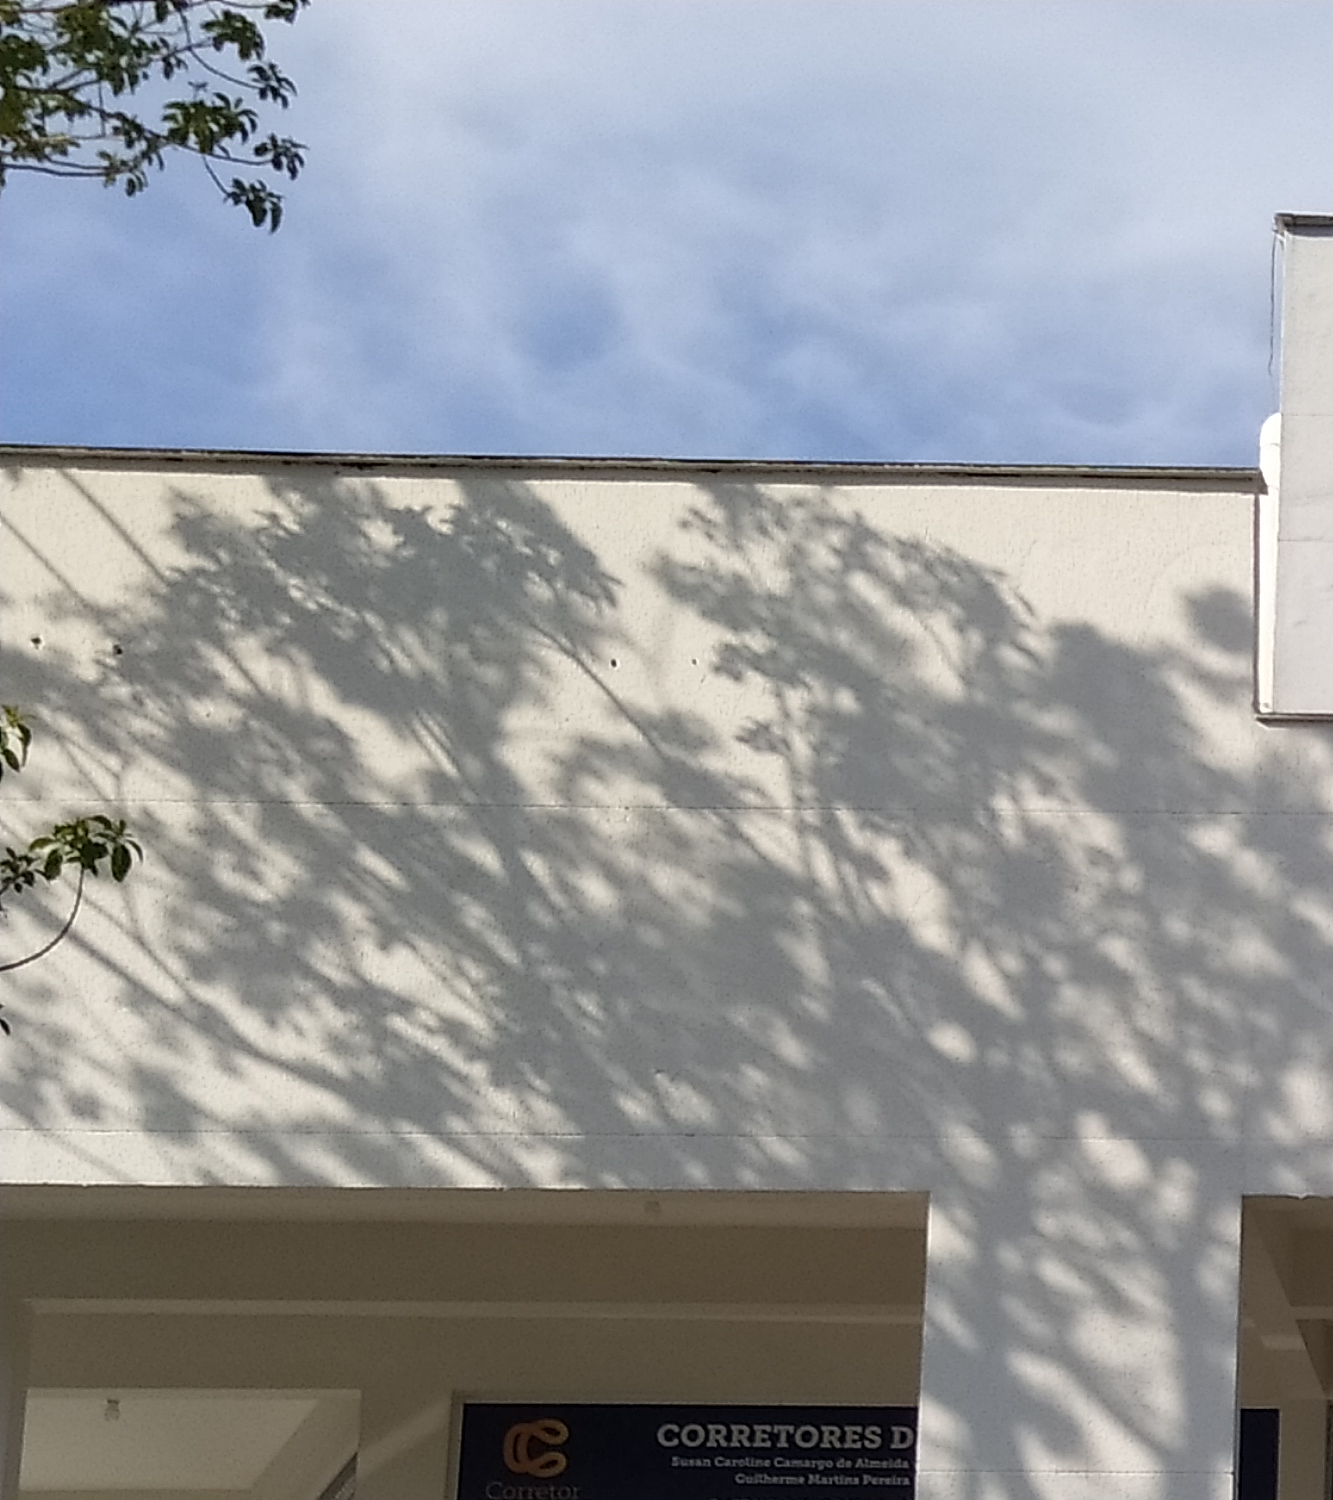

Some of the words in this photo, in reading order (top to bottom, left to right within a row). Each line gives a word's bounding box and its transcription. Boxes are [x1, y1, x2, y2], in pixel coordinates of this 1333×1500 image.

[657, 1424, 882, 1449] CORRETORES
[714, 1456, 771, 1468] Caroline
[774, 1457, 833, 1470] Camargo
[836, 1458, 853, 1469] de
[855, 1458, 909, 1470] Almeida
[735, 1473, 805, 1485] Guilherme
[862, 1475, 911, 1486] Pereira
[485, 1481, 580, 1500] Corretor
